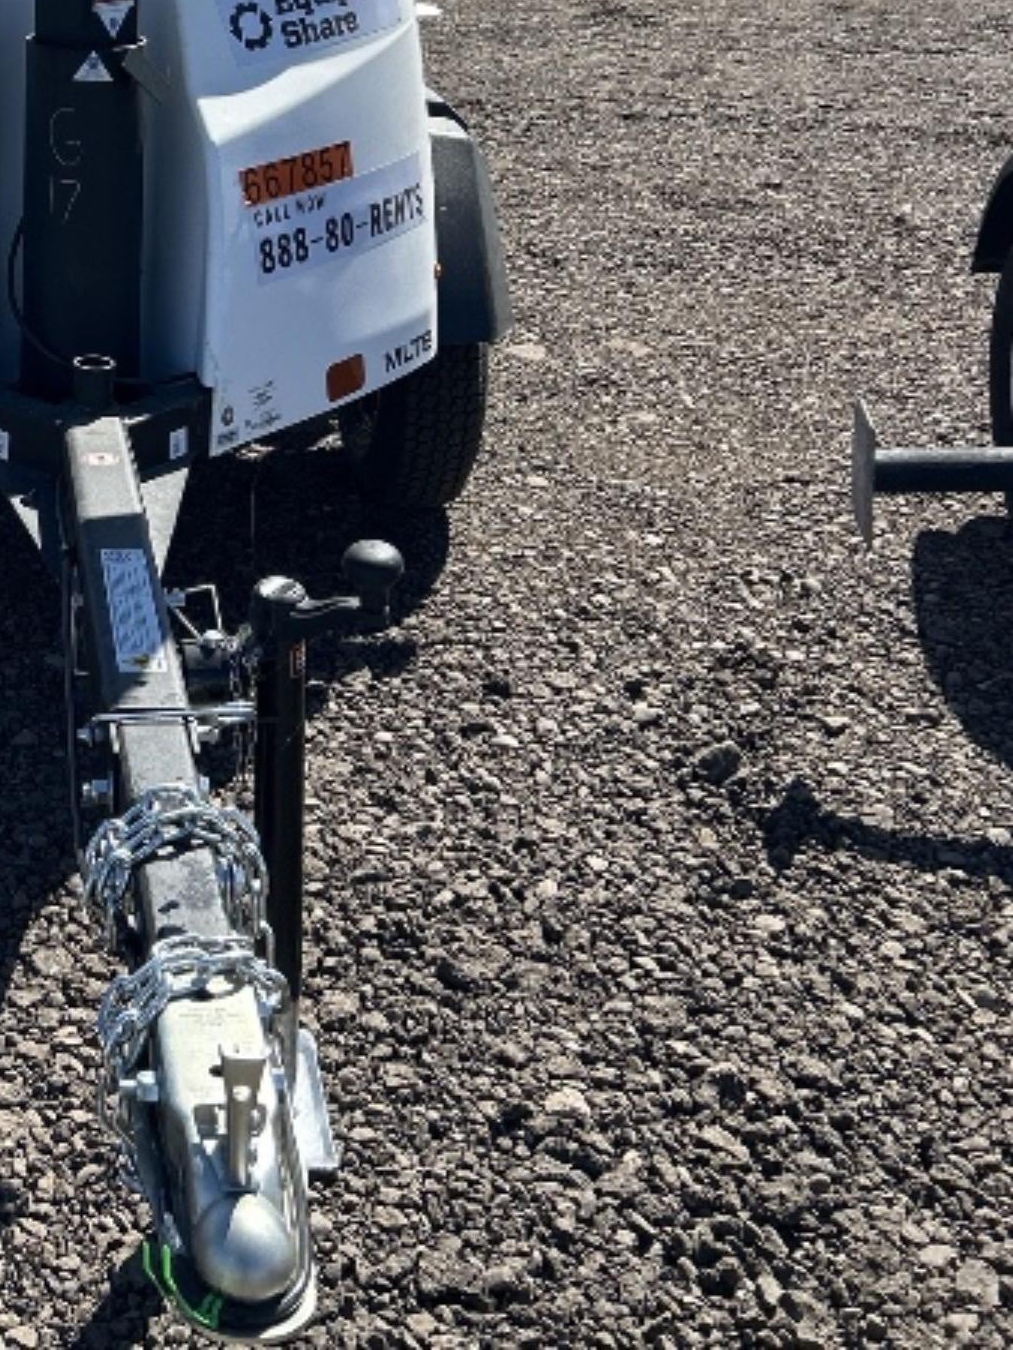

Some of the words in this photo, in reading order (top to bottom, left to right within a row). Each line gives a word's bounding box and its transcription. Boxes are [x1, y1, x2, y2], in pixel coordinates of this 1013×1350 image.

[280, 10, 359, 48] Share
[242, 143, 351, 206] 667857
[253, 203, 291, 228] CALL
[260, 183, 424, 274] 888-80-RENTS
